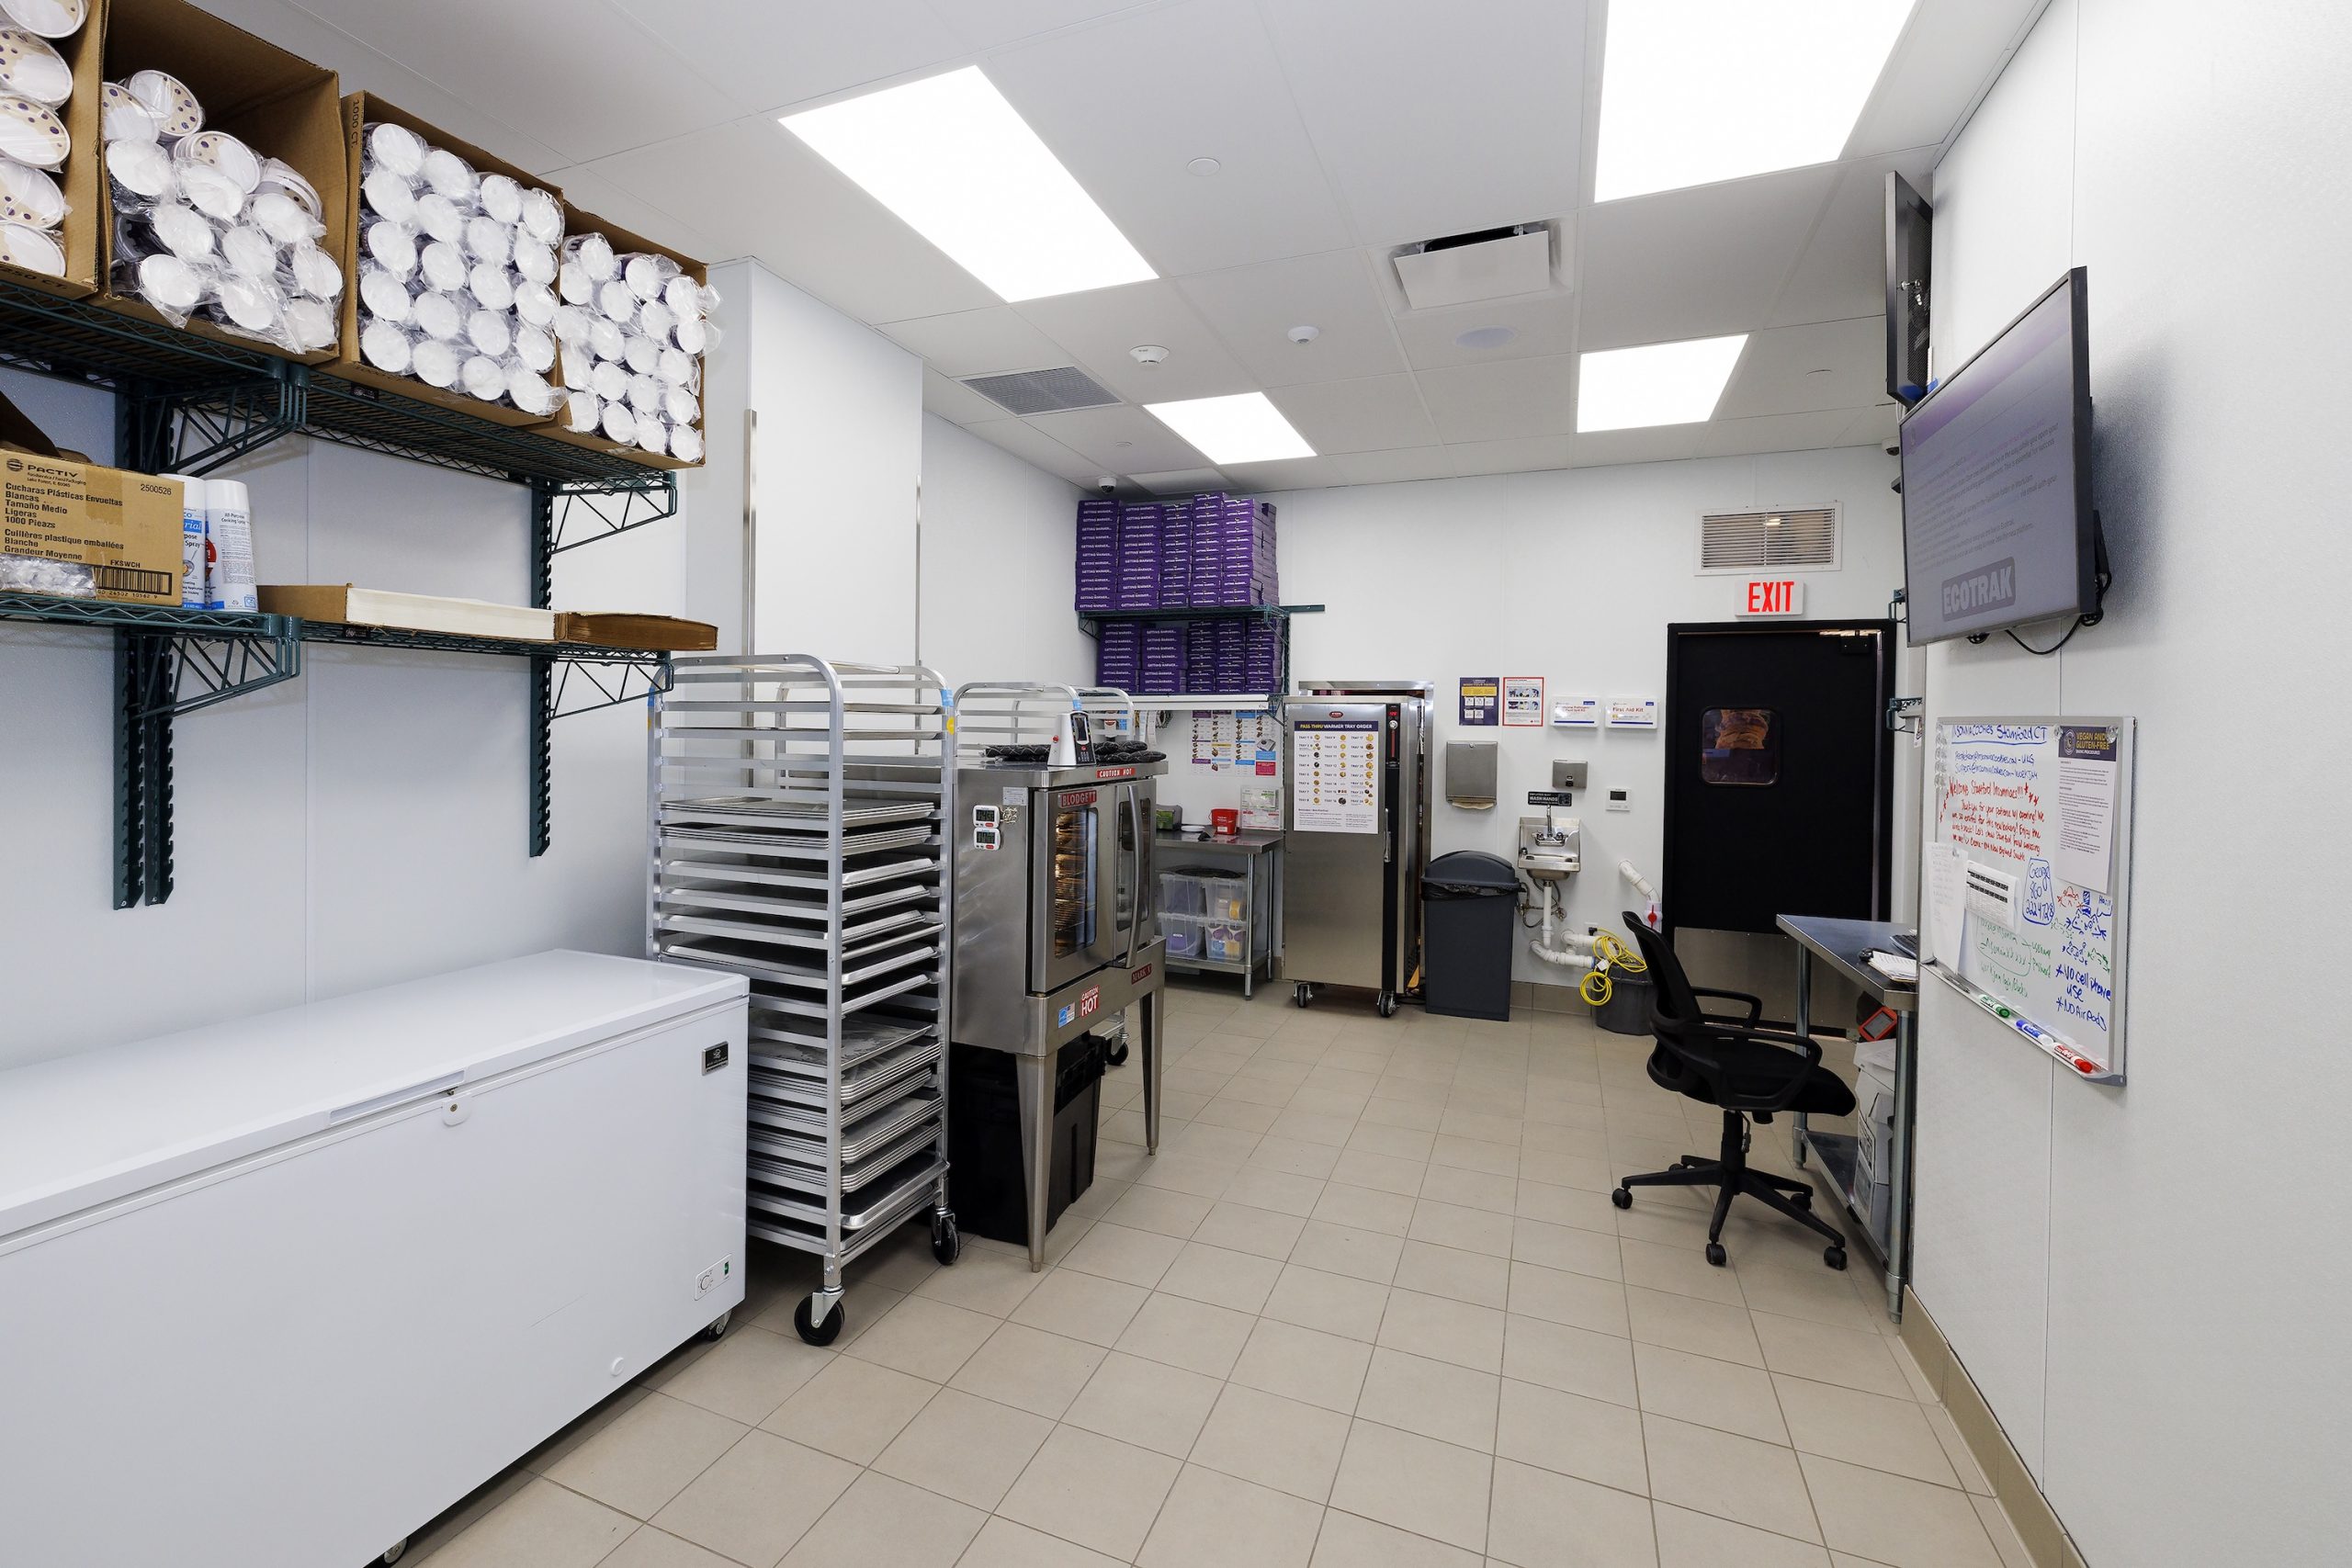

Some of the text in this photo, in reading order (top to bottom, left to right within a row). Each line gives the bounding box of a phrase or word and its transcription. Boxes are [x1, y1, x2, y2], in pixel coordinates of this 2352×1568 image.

[28, 464, 78, 478] PACTIV
[6, 482, 45, 495] Cucharas
[47, 488, 84, 501] Plásticas
[141, 483, 172, 495] 2500526
[6, 491, 40, 502] Blancas
[5, 508, 37, 519] Ligeras
[6, 499, 68, 514] Tamaño Medio
[5, 516, 26, 525] 1000
[5, 528, 124, 550] Cuillères plastique emballées
[5, 537, 39, 547] Blanche
[5, 546, 83, 560] Grandeur Moyenne
[110, 559, 141, 568] FKSWCH
[1747, 581, 1794, 613] EXIT
[1943, 565, 2013, 615] ECOTRAK
[1099, 768, 1132, 778] CAUTION HOT
[1062, 791, 1097, 807] BLODGETT
[1081, 995, 1098, 1017] HOT
